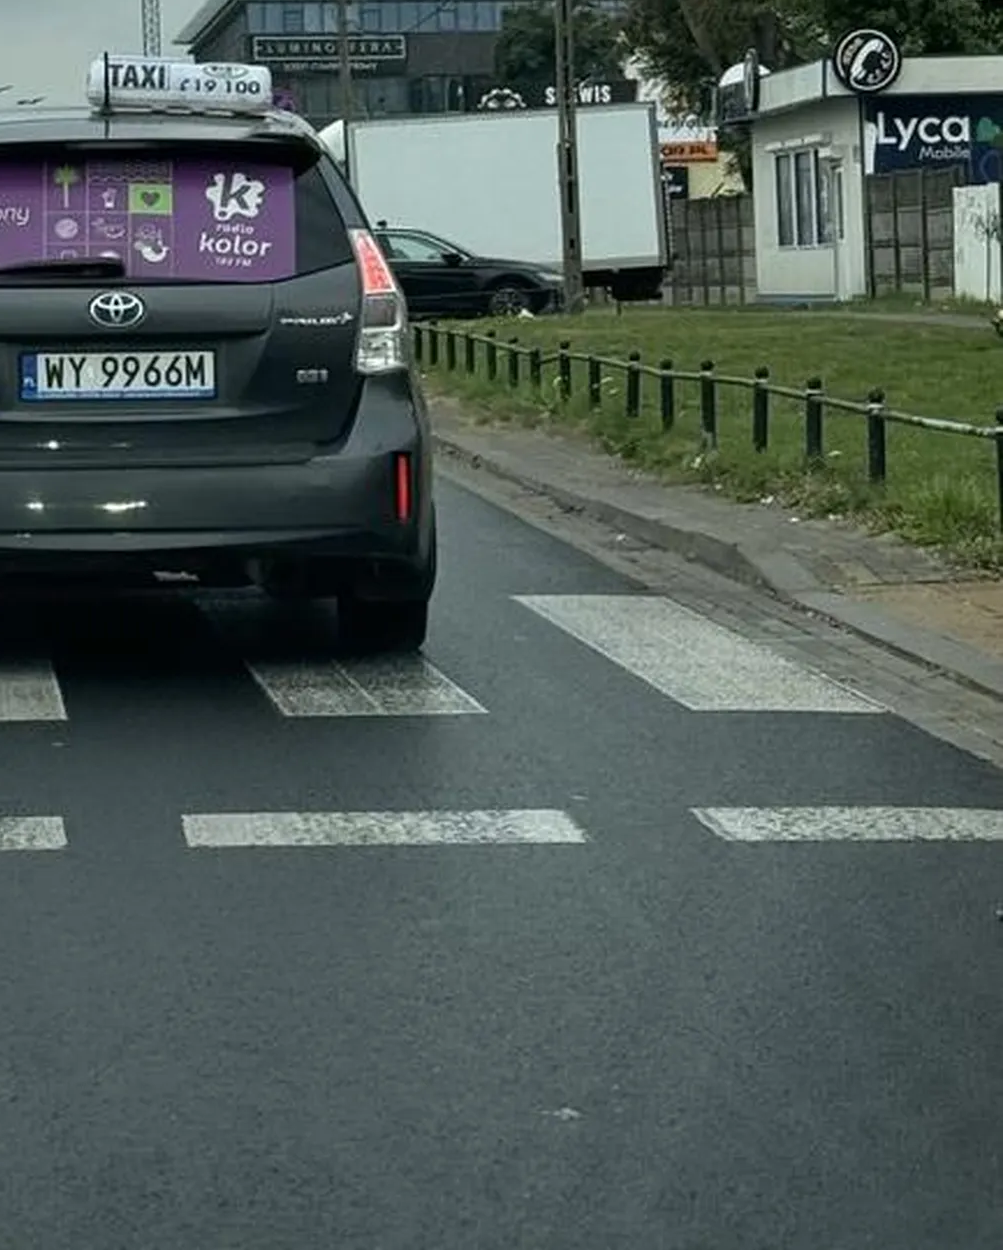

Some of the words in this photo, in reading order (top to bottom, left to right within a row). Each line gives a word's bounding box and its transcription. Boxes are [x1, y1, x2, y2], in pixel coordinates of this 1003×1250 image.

[110, 64, 165, 89] TAXI
[226, 81, 261, 94] 100
[545, 85, 611, 105] SWIS
[877, 111, 970, 150] Lyca
[919, 145, 971, 160] Mobile
[199, 232, 272, 256] kolor
[45, 356, 87, 389] WY
[101, 354, 206, 388] 9966M
